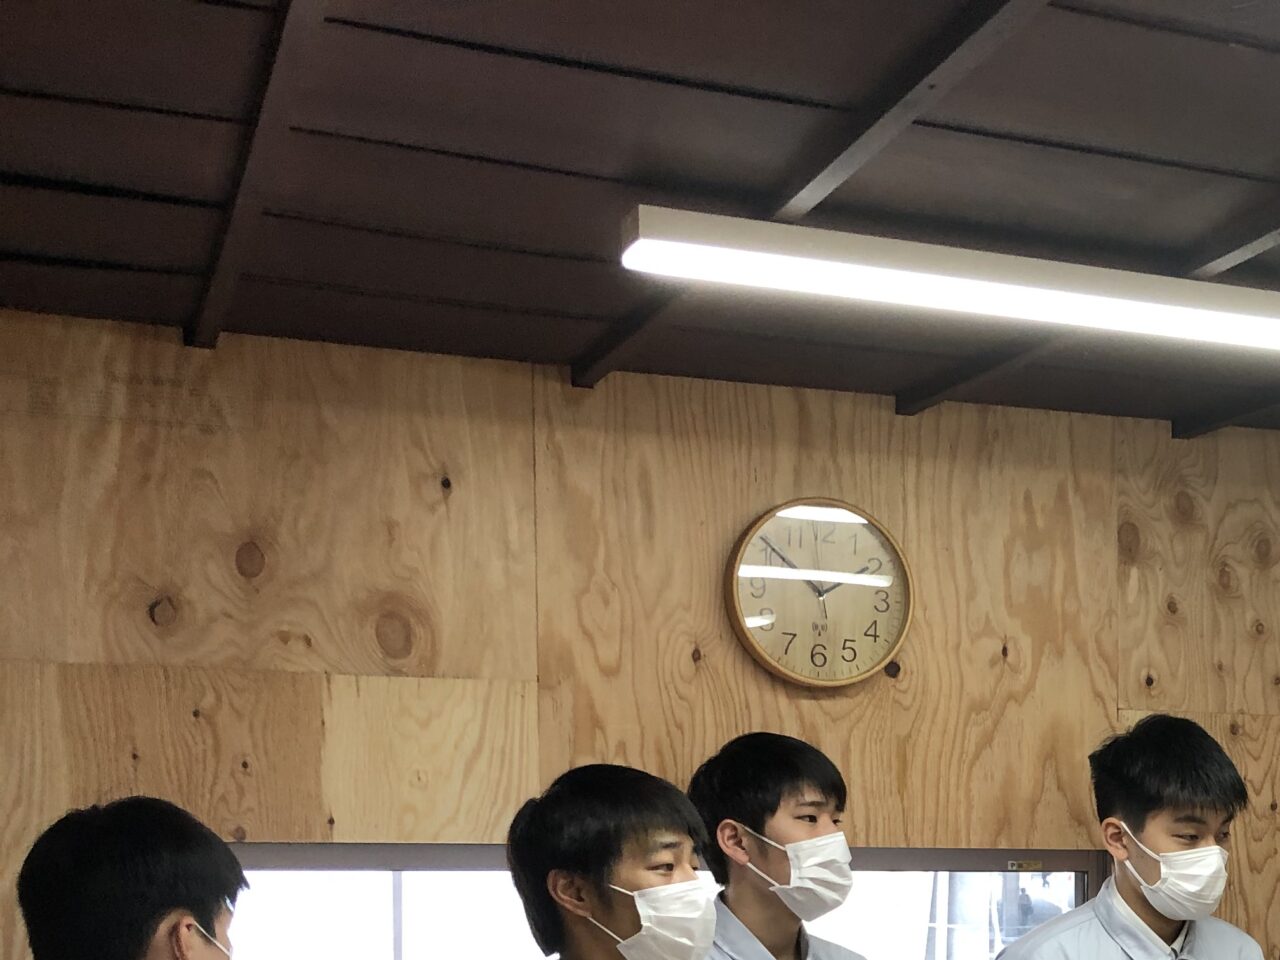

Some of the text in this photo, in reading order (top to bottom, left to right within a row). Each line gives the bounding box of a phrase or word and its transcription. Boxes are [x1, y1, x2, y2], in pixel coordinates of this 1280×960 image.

[786, 526, 803, 549] 11
[850, 532, 858, 556] 1
[750, 576, 766, 599] 9
[874, 589, 890, 613] 3
[758, 607, 774, 632] 8
[863, 619, 880, 643] 4
[781, 631, 797, 655] 7
[841, 638, 857, 662] 5
[810, 643, 828, 668] 6
